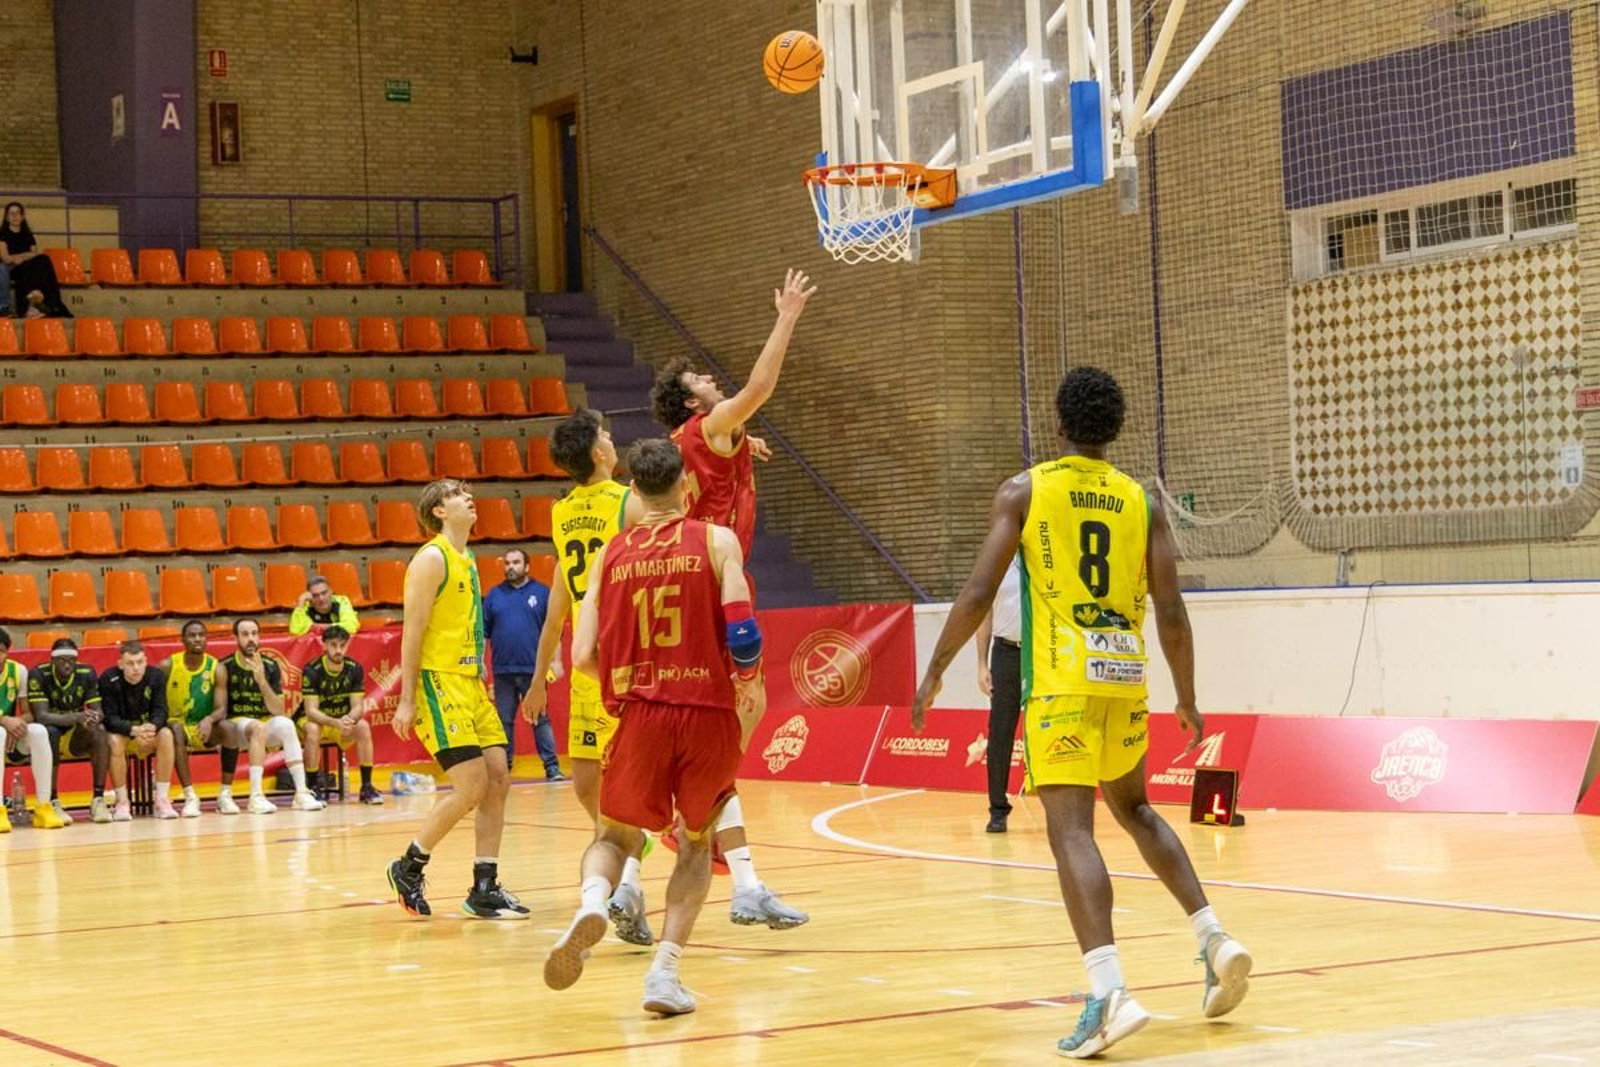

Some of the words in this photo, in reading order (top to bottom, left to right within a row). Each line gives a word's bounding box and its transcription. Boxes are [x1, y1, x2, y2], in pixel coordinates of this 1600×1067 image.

[161, 102, 181, 129] A
[3, 368, 16, 378] 12
[54, 368, 66, 378] 11
[104, 368, 116, 377] 10
[67, 503, 80, 513] 12
[1070, 491, 1124, 514] BAMADU
[1039, 521, 1053, 569] RUSTER
[611, 563, 633, 584] JAVI
[635, 554, 702, 577] MARTÍNEZ
[1079, 520, 1110, 598] 8
[632, 584, 682, 649] 15
[683, 667, 710, 678] ACM
[815, 673, 842, 692] 35
